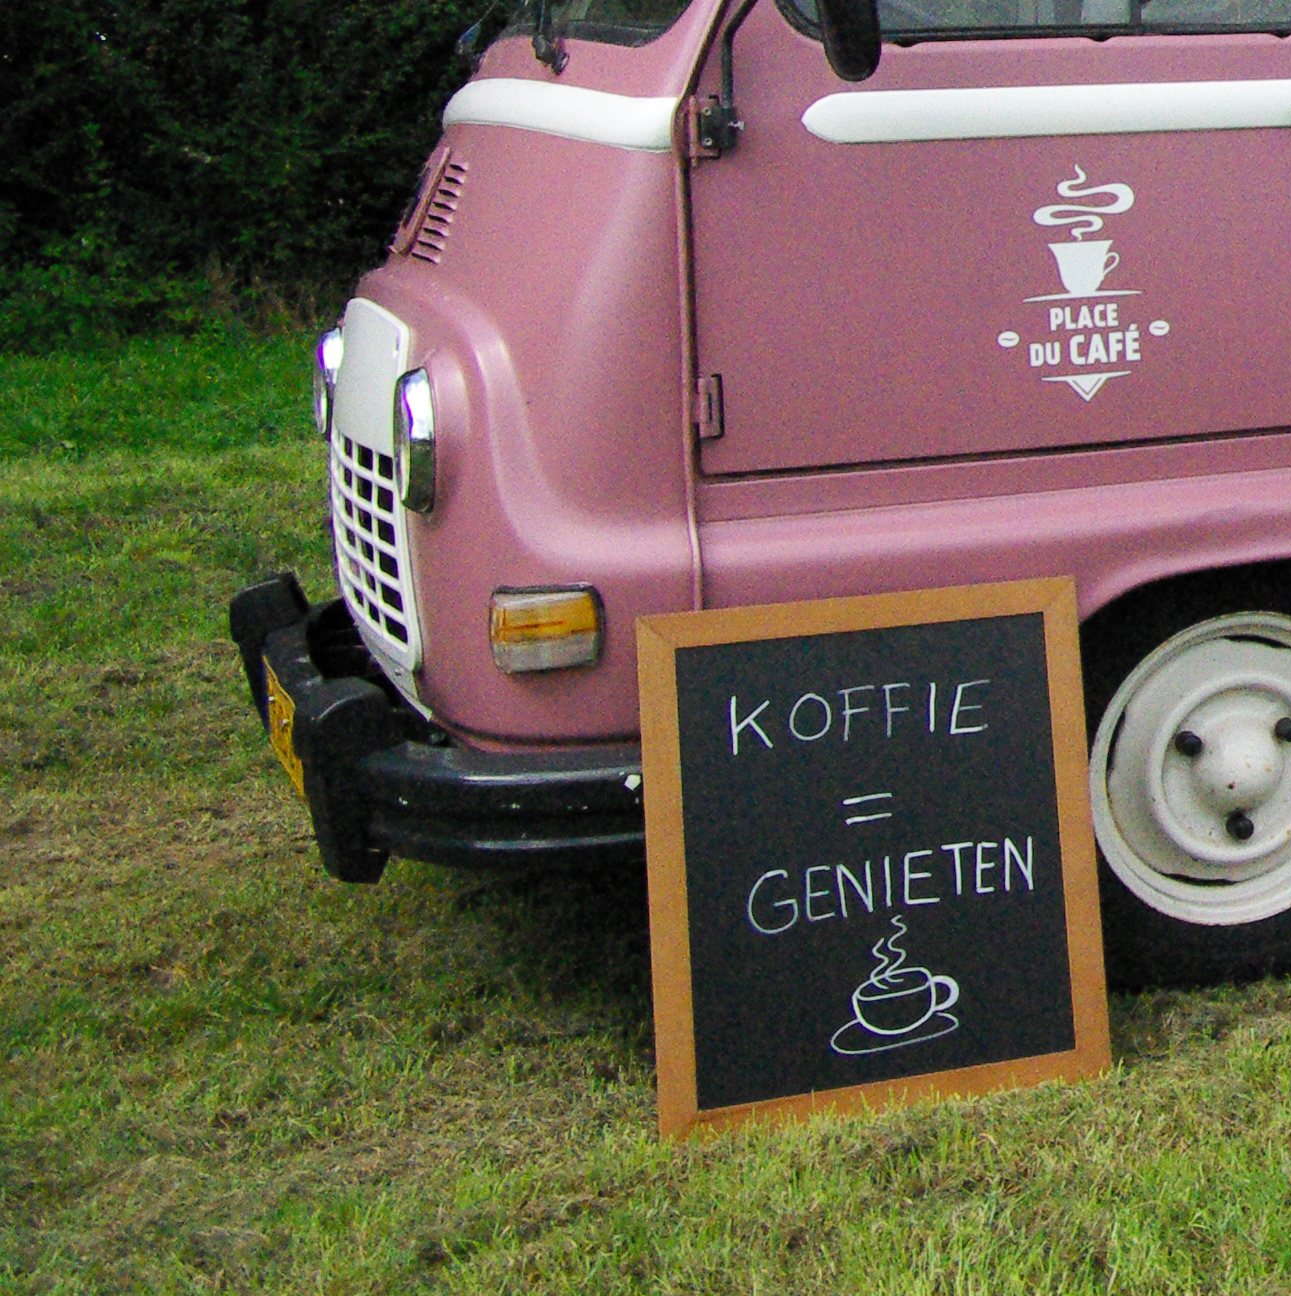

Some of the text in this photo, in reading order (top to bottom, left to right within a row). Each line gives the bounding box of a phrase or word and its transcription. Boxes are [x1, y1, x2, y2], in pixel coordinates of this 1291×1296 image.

[1029, 323, 1142, 367] DU CAFÉ
[1050, 303, 1119, 331] PLACE
[729, 679, 990, 756] KOFFIE
[748, 835, 1034, 934] GENIETEN
